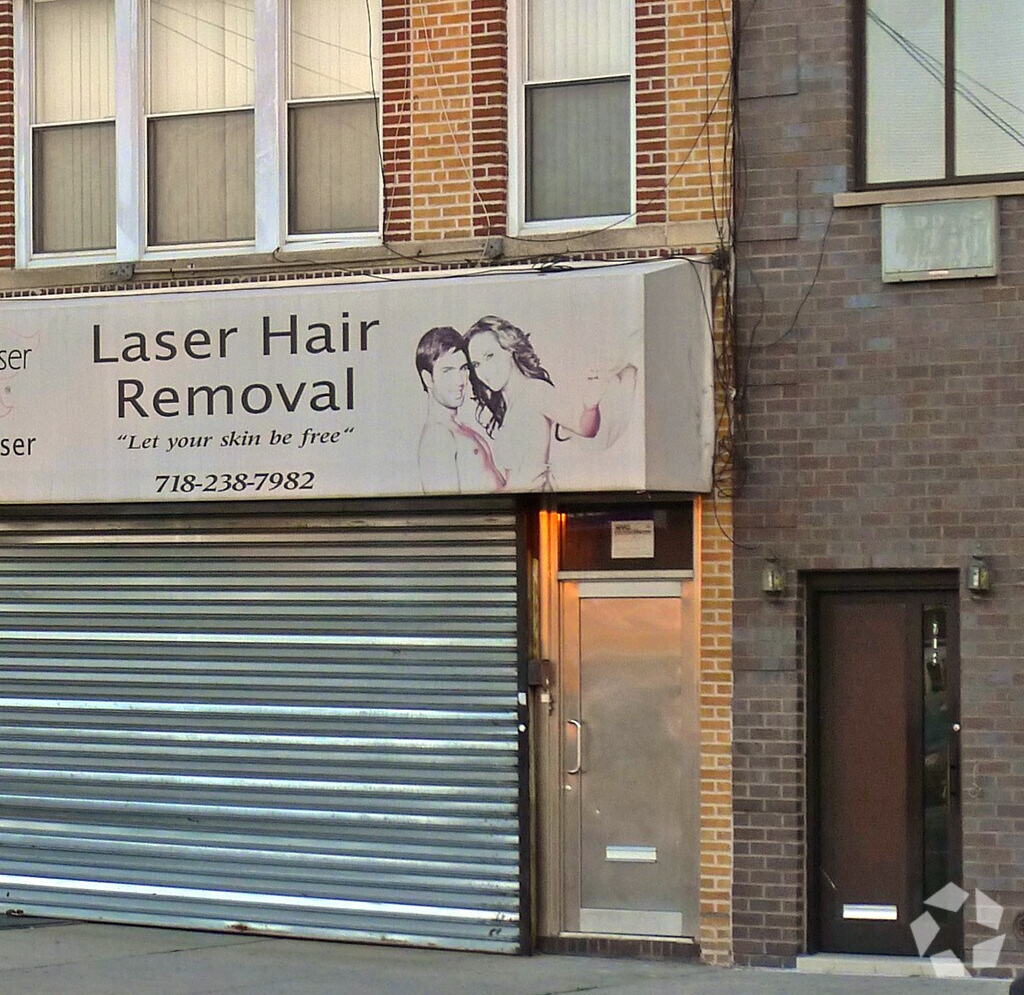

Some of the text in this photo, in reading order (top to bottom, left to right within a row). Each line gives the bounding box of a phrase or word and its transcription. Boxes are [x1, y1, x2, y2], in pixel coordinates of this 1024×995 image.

[93, 311, 380, 364] Laser Hair
[117, 368, 356, 419] Removal
[167, 435, 213, 451] your
[219, 429, 262, 447] skin
[270, 428, 293, 445] be
[154, 471, 315, 493] 718-238-7982
